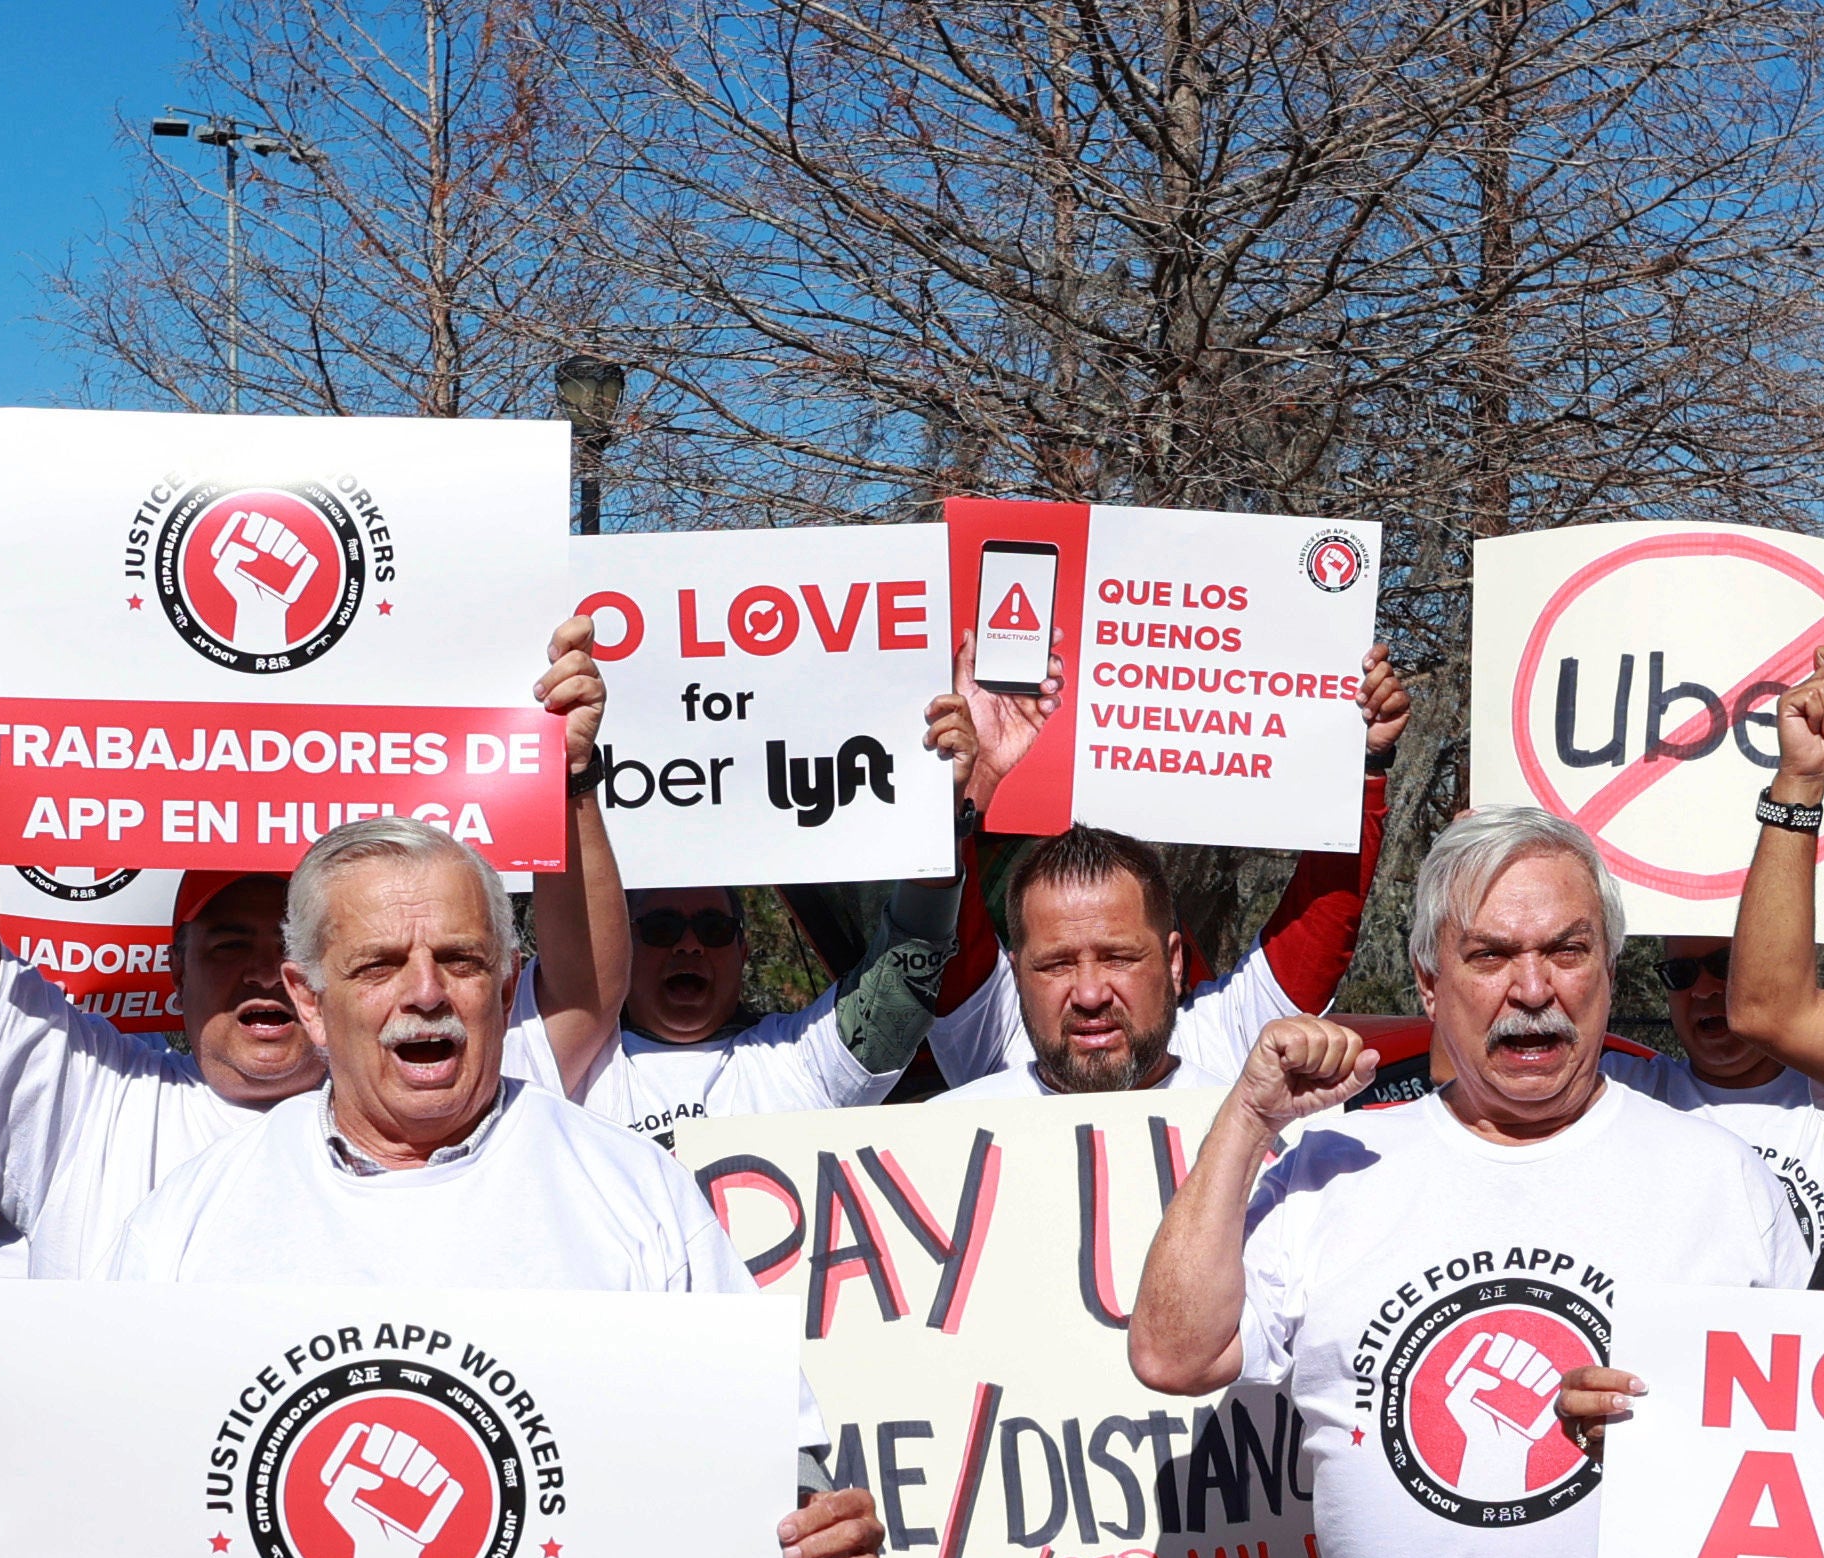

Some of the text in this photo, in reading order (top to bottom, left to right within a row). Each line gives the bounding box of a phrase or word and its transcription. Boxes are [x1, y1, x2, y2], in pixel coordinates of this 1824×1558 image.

[125, 469, 395, 582] JUSTICE ORKERS
[305, 485, 346, 527] JUSTICIA
[1098, 578, 1248, 612] QUE LOS
[678, 581, 928, 658] LOVE
[987, 633, 1040, 641] DESACTIVADO
[1096, 620, 1242, 653] BUENOS
[193, 635, 238, 664] ADOLAT
[681, 684, 755, 722] for
[1092, 663, 1361, 702] CONDUCTORES
[1091, 704, 1287, 739] VUELVAN A
[1555, 651, 1792, 768] Ube
[465, 733, 542, 776] DE
[1089, 745, 1273, 780] TRABAJAR
[602, 735, 895, 827] ber lyft
[22, 798, 145, 843] APP
[163, 800, 237, 845] EN
[695, 1127, 1001, 1341] PAY
[1479, 1286, 1507, 1300] 公正
[1354, 1247, 1575, 1412] JUSTICE FOR APP
[347, 1367, 381, 1386] 公正
[1387, 1302, 1461, 1428] СПРАВЕДЛИВОСТЬ
[207, 1323, 566, 1516] JUSTICE FOR APP WORKERS
[446, 1387, 500, 1443] JUSTICIA
[255, 1387, 330, 1533] СПРАВЕДЛИВОСТЬ
[1410, 1478, 1460, 1513] ADOLAT
[1482, 1506, 1526, 1521] 정당성
